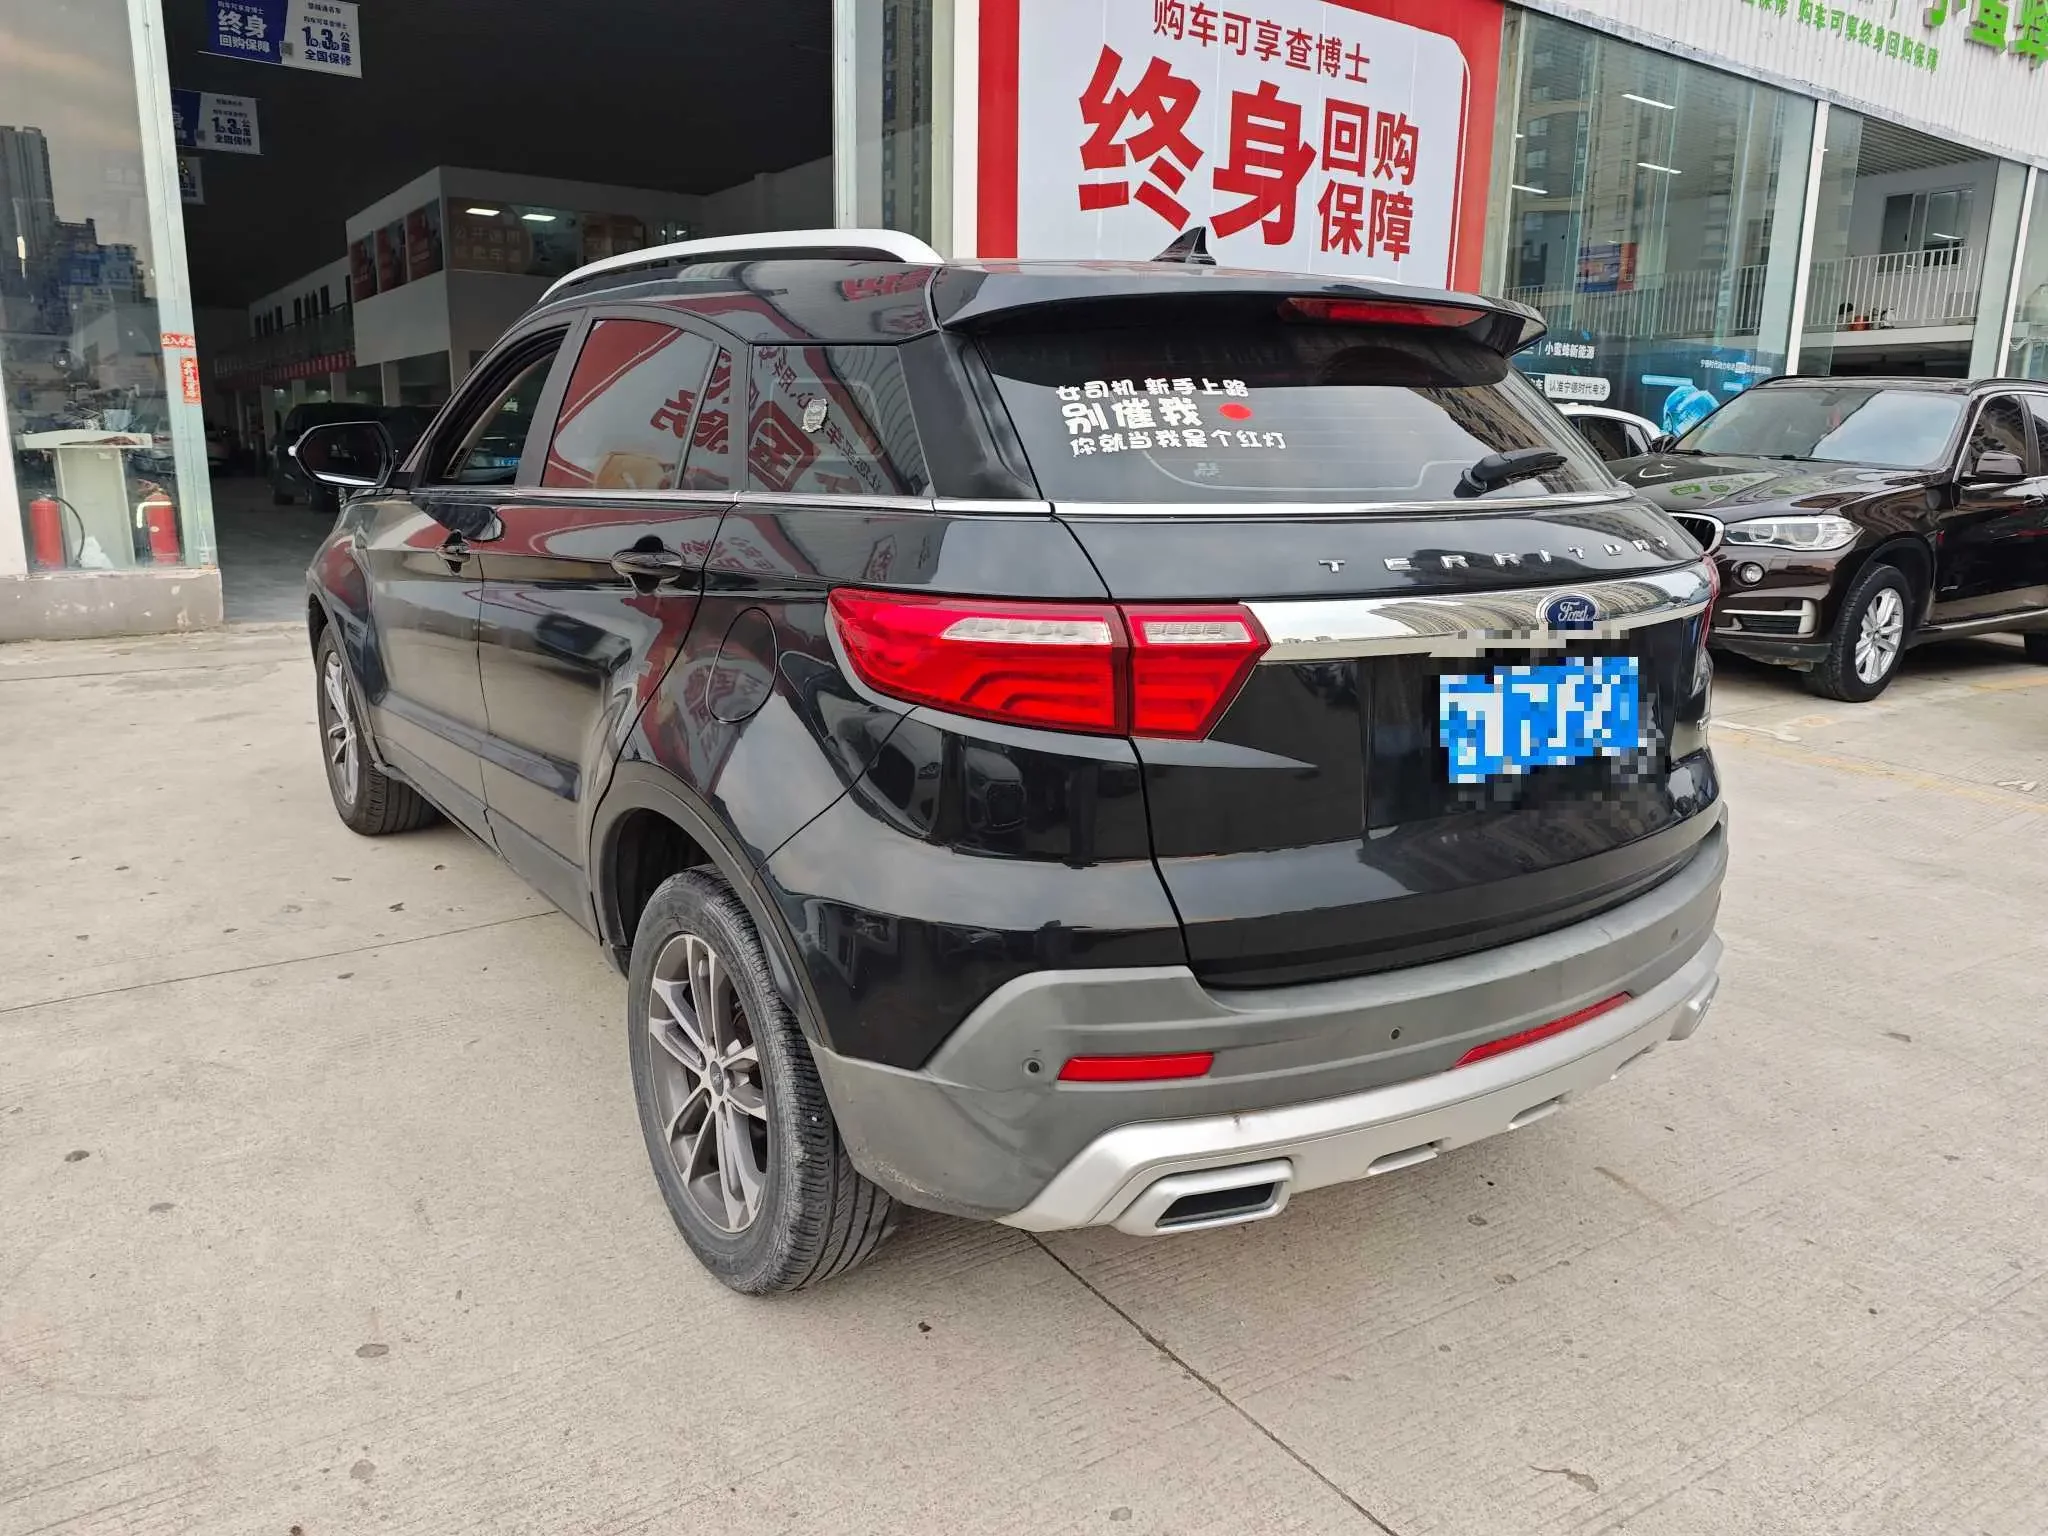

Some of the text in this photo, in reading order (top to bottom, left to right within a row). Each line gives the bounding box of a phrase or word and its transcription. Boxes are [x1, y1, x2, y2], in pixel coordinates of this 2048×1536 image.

[217, 9, 268, 38] 终身
[219, 34, 270, 53] 回购保障
[305, 49, 352, 66] 全国保修
[1153, 0, 1371, 84] 购车可享查博士
[1078, 44, 1317, 245] 终身
[1321, 98, 1419, 186] 回购
[1316, 179, 1414, 262] 保障
[1056, 377, 1249, 401] 女司机 新手上路
[1061, 397, 1203, 434] 别催我
[1070, 429, 1287, 457] 你就当我是个红灯
[1318, 536, 1669, 573] TERRITORY
[1558, 601, 1590, 622] Ford
